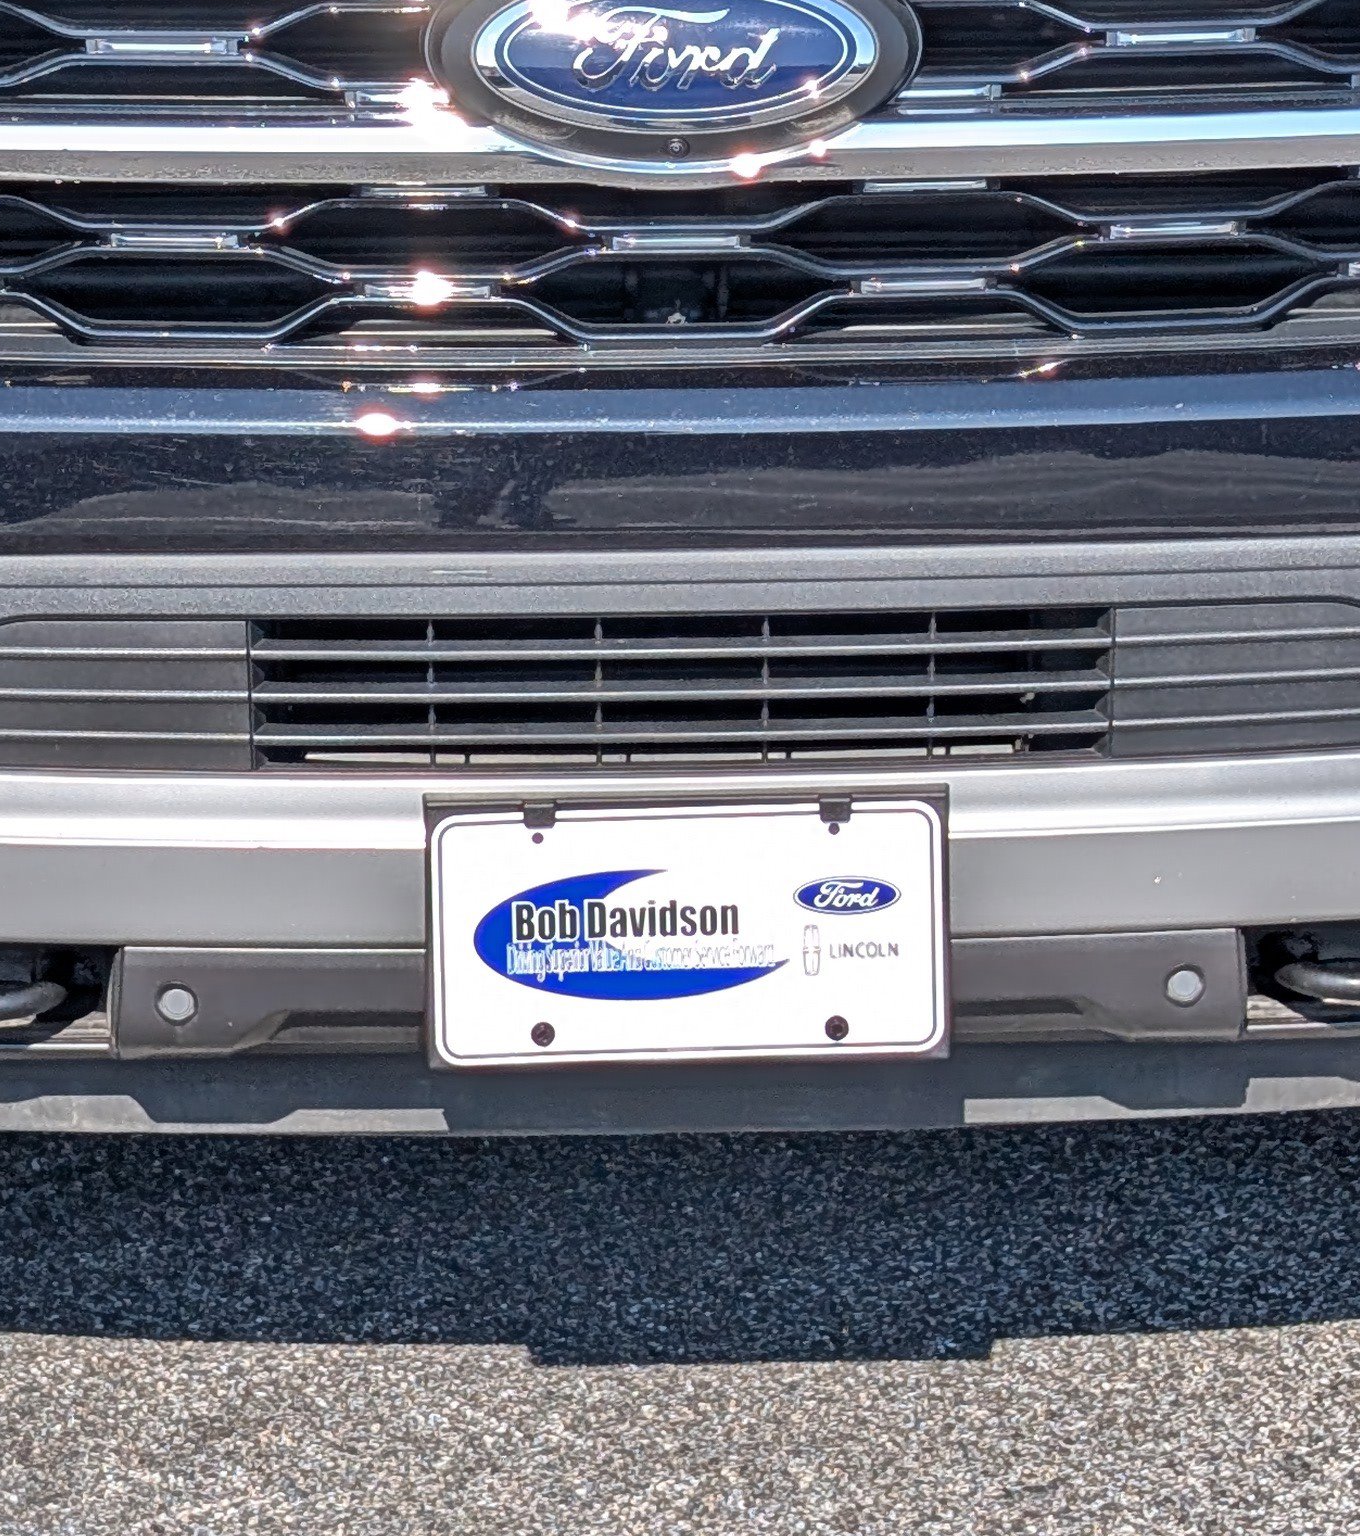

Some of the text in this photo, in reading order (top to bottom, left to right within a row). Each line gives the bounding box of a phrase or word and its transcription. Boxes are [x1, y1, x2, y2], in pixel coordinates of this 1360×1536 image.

[573, 4, 782, 94] Ford
[813, 881, 880, 907] Ford
[513, 899, 740, 942] Bob Davidson
[829, 941, 899, 959] LINCOLN
